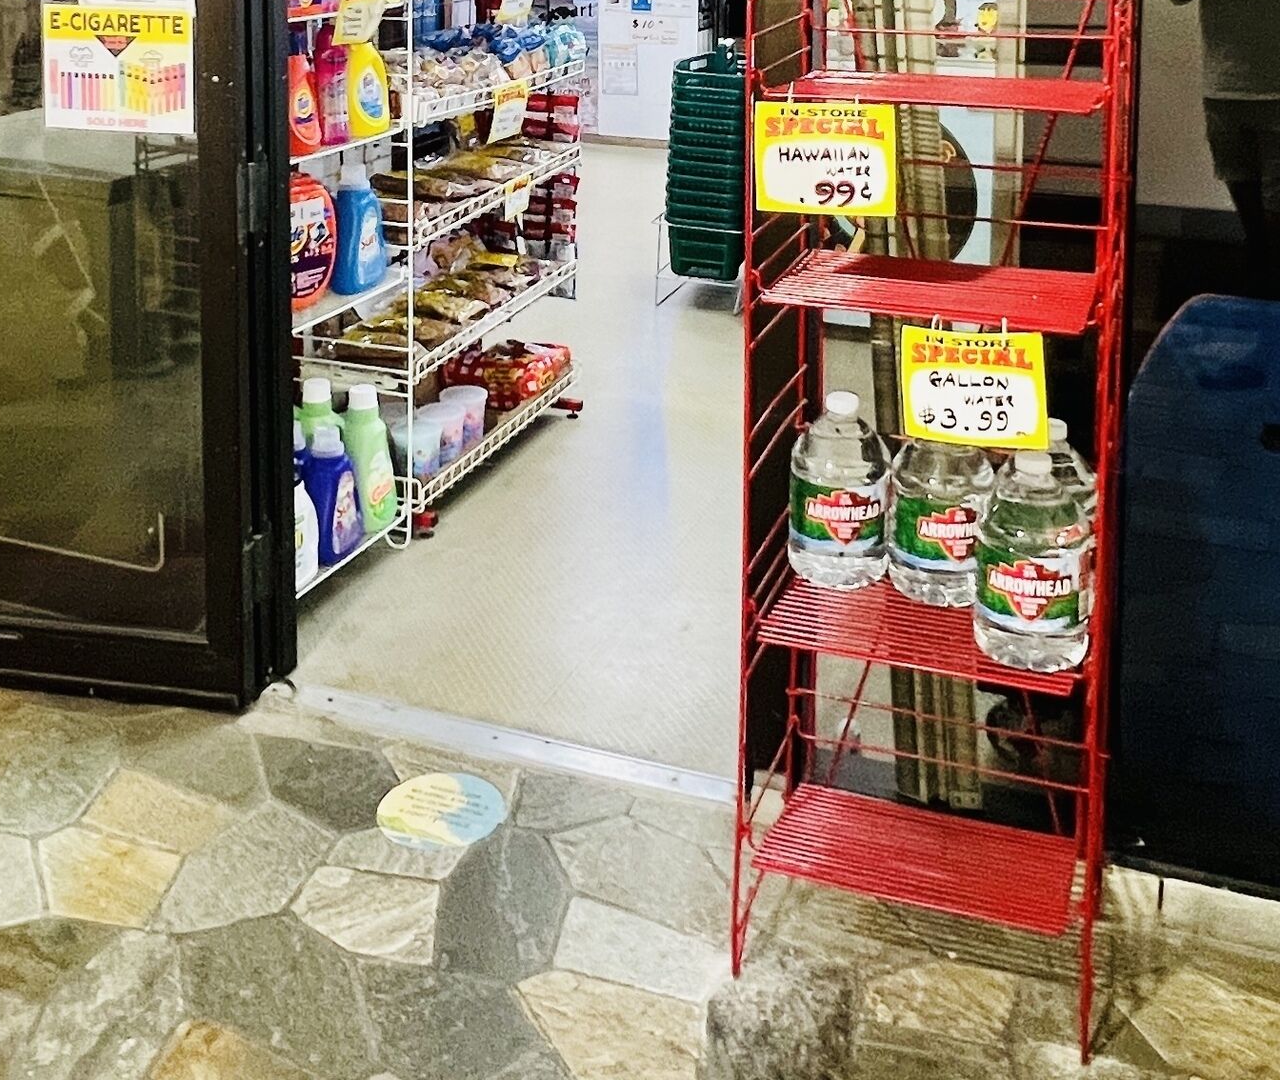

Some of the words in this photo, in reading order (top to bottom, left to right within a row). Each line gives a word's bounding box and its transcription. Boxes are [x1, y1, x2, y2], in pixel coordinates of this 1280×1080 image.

[49, 11, 184, 35] E-CIGARETTE
[85, 116, 116, 127] SOLD
[118, 118, 149, 129] HERE
[780, 108, 868, 118] IN-STORE
[765, 116, 885, 141] SPECIAL
[778, 146, 870, 163] HAWAIIAN
[826, 166, 871, 177] WATER
[926, 335, 1016, 348] IN-STORE
[911, 342, 1034, 371] SPECIAL
[928, 370, 1009, 390] GALLON
[964, 395, 1015, 408] WATER
[919, 404, 1009, 433] $3.99
[807, 502, 880, 521] ARROWHEAD
[989, 569, 1071, 597] ARROWHEAD
